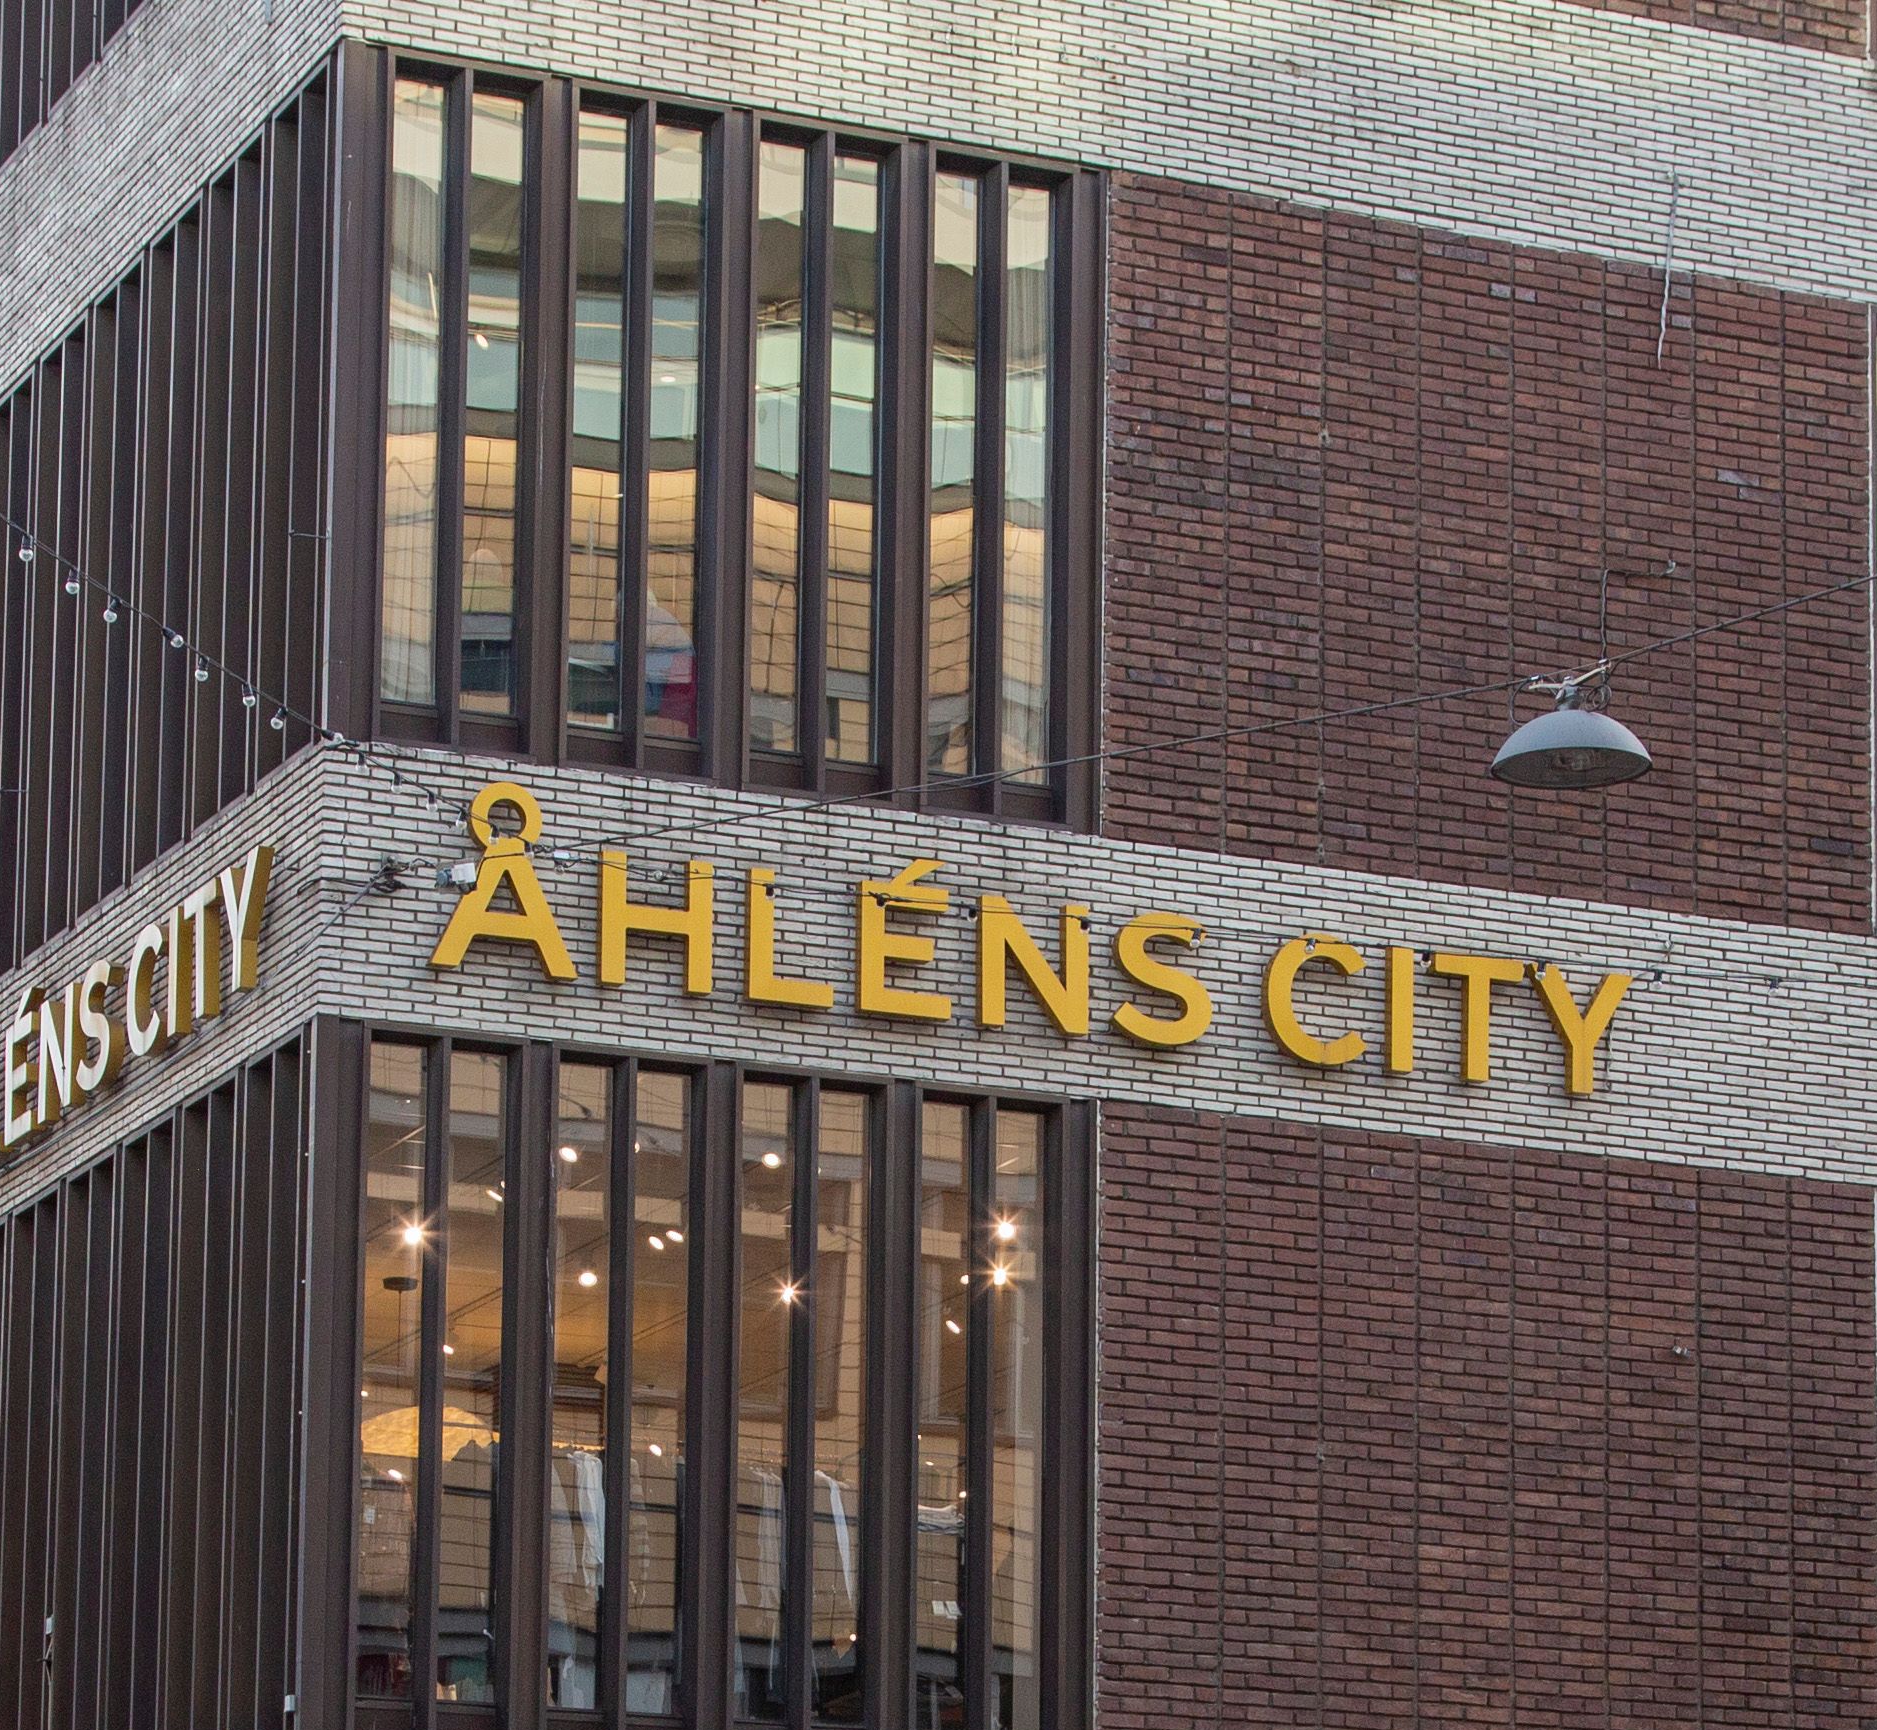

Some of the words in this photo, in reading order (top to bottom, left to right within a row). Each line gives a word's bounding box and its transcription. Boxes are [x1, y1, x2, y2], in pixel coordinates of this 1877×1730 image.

[127, 845, 276, 1056] CITY
[428, 781, 1213, 1048] ÅHLÉNS
[1265, 933, 1632, 1096] CITY
